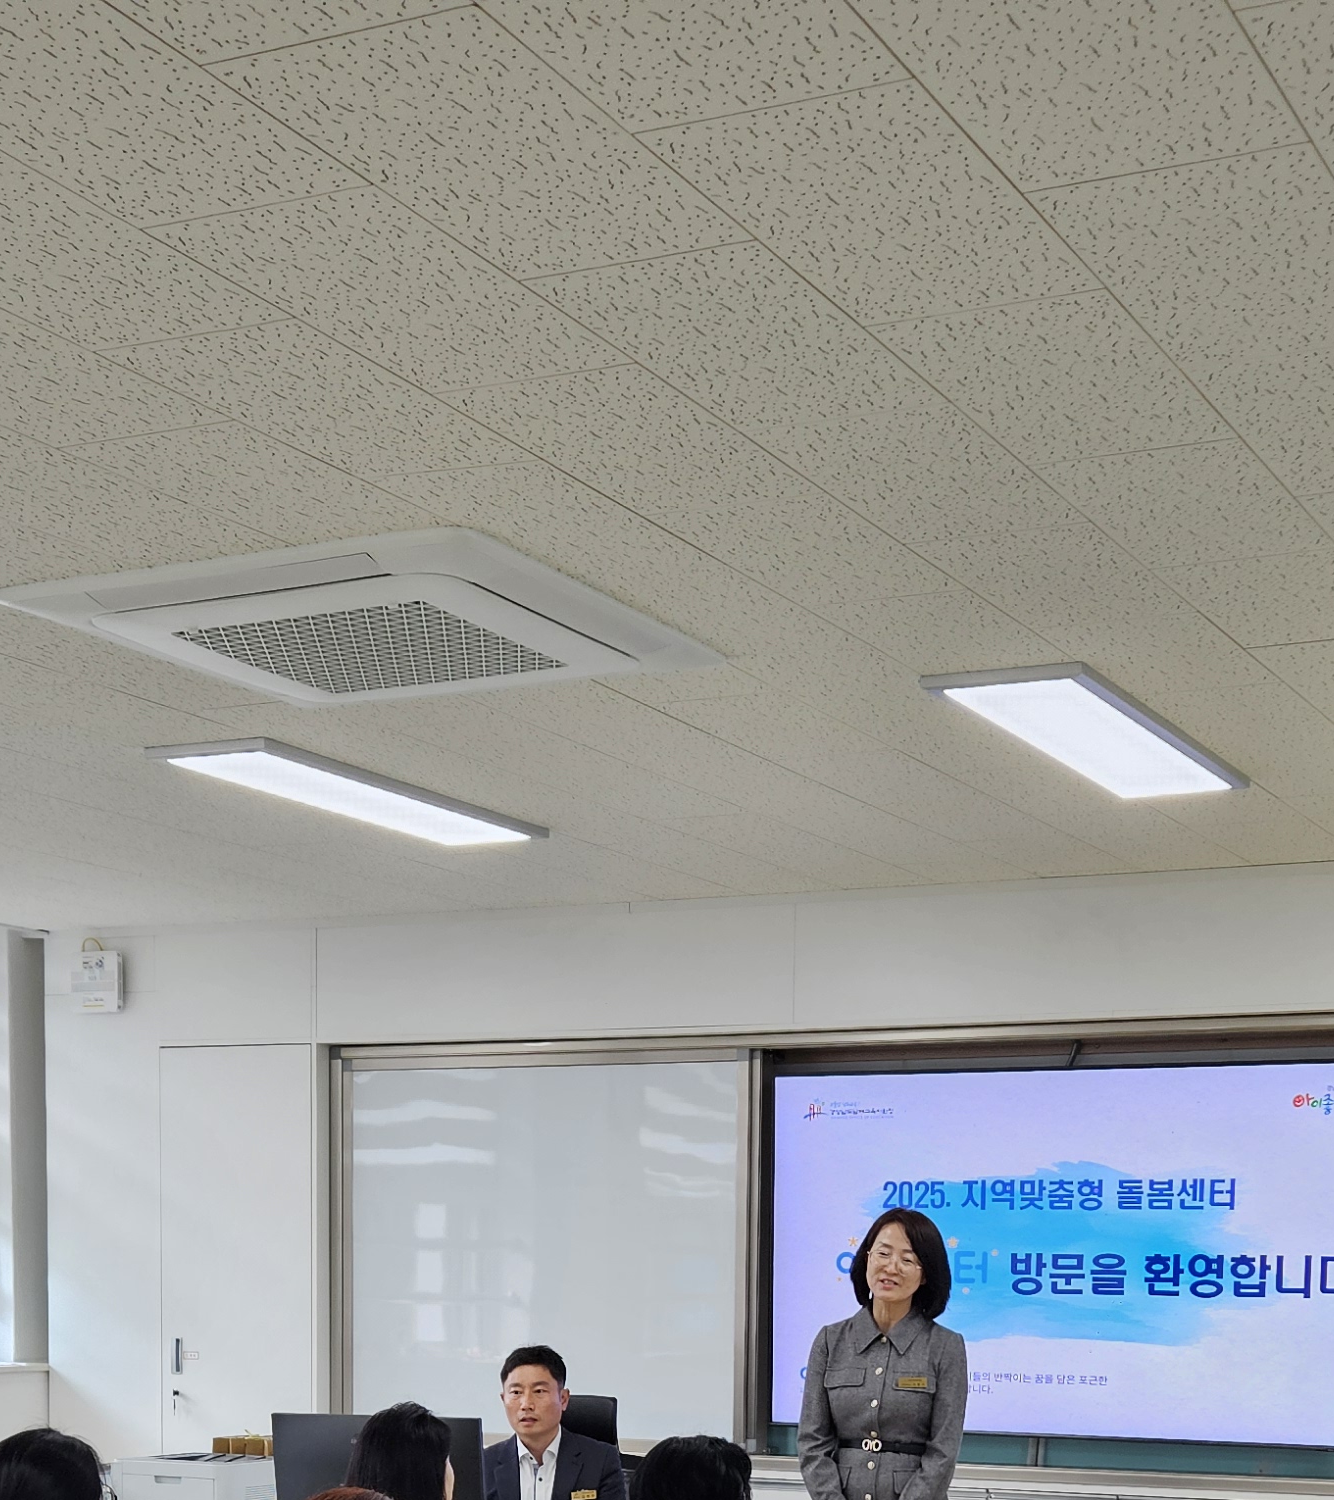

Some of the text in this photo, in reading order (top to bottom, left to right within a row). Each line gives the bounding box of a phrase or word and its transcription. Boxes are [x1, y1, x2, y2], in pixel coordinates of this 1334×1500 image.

[882, 1177, 1237, 1211] 2025. 지역맞춤형 돌봄센터
[1010, 1252, 1127, 1296] 방문을
[993, 1372, 1032, 1384] 반짝이는
[1035, 1373, 1053, 1385] 꿈을
[1056, 1374, 1075, 1385] 담은
[1078, 1375, 1108, 1386] 포근한
